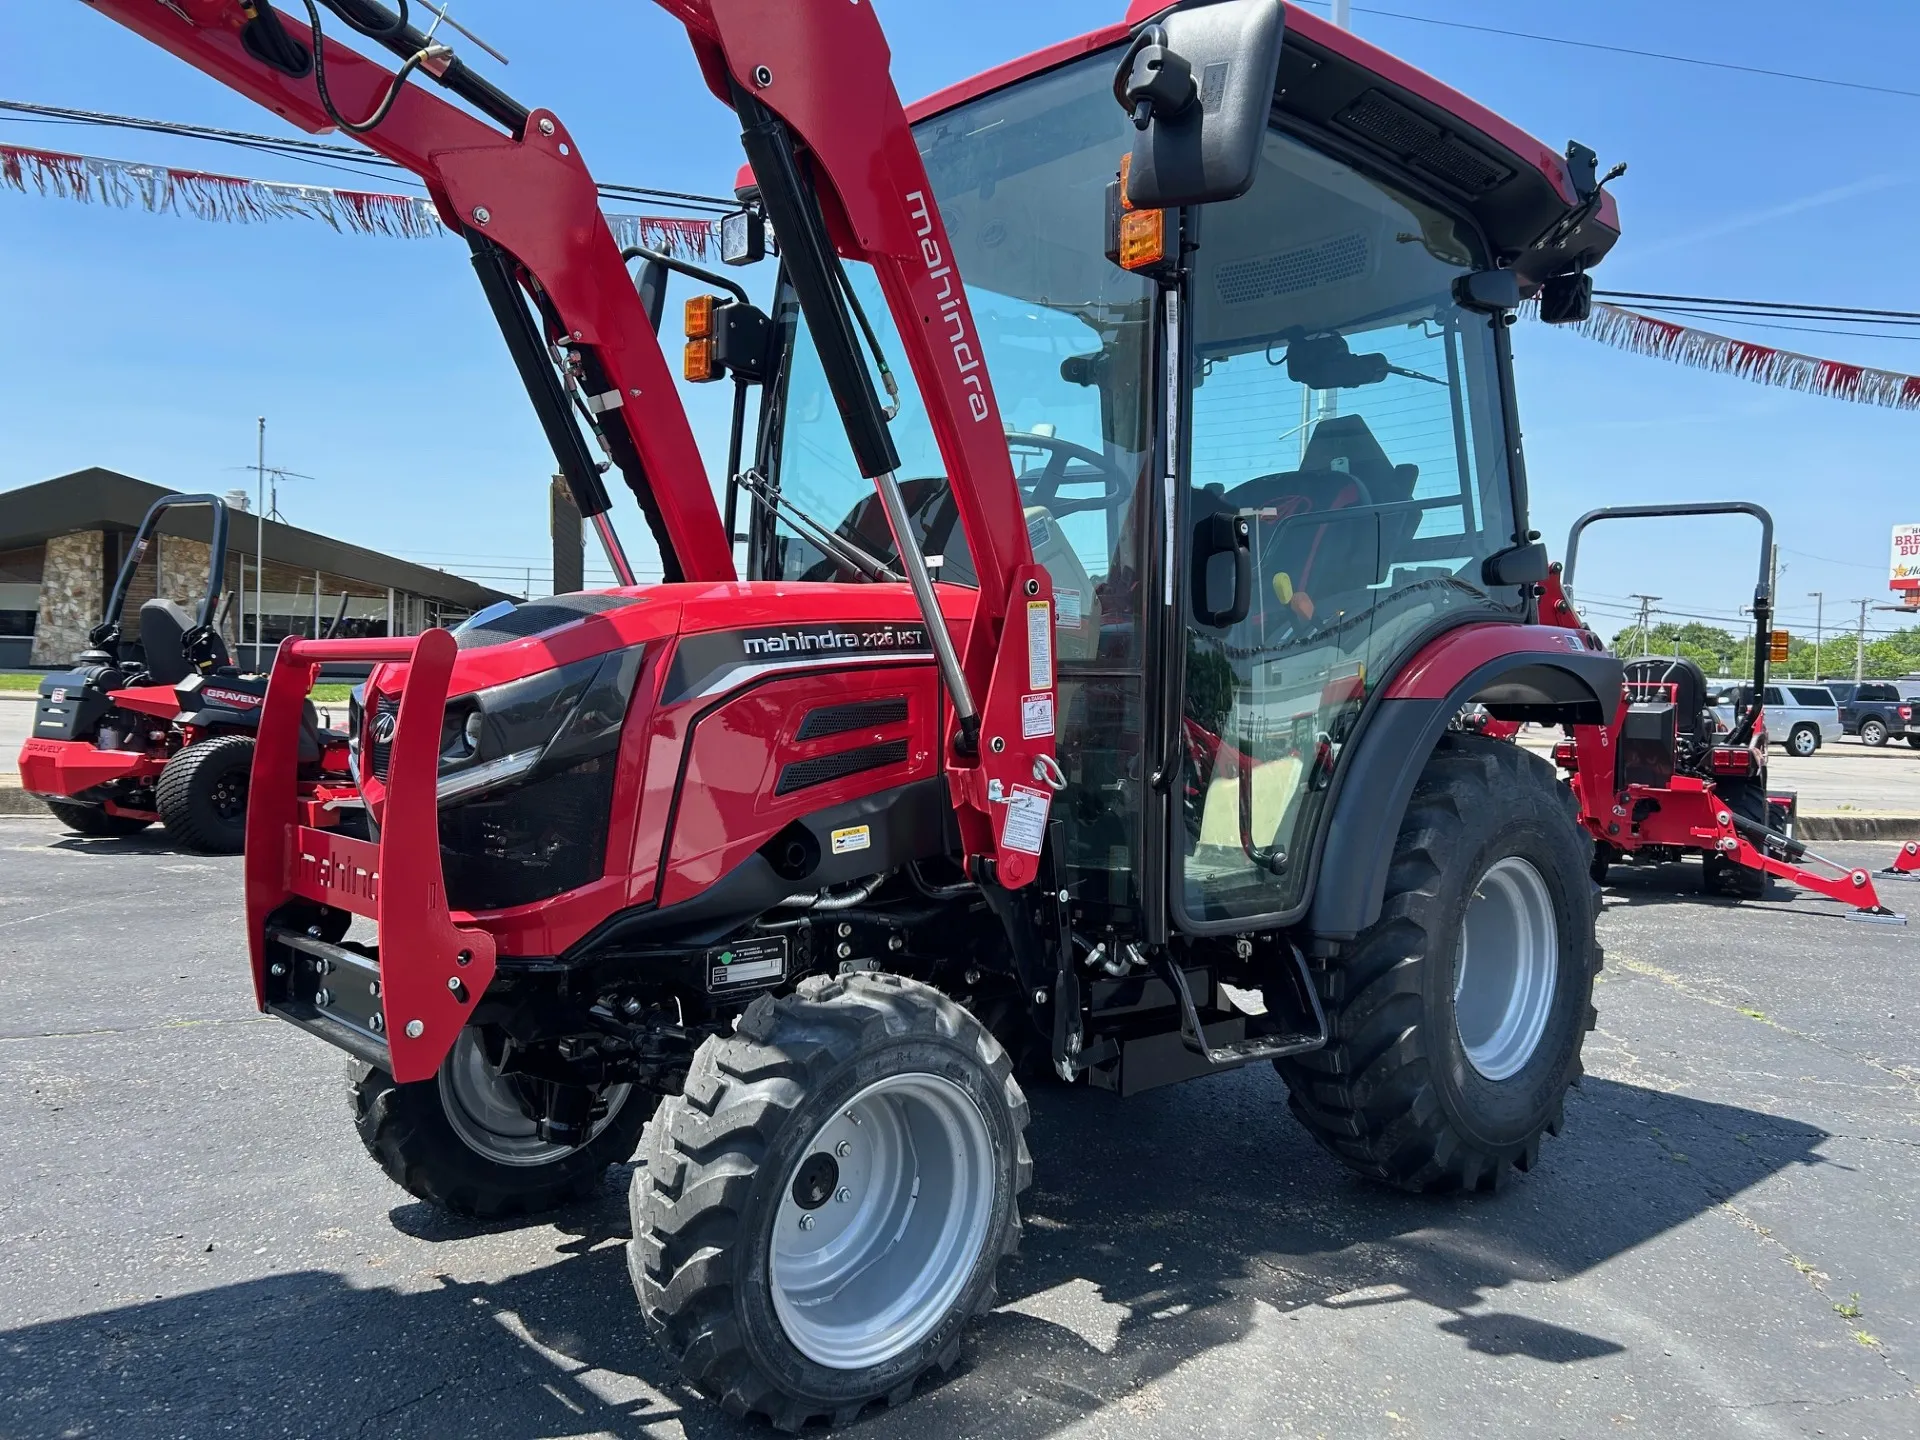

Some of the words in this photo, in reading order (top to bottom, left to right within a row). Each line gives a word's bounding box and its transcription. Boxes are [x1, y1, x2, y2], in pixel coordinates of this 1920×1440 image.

[906, 190, 988, 423] mahindra
[1900, 546, 1920, 555] BU
[743, 630, 860, 653] mahindra
[897, 631, 922, 645] HST
[206, 689, 261, 704] GRAVELY
[28, 744, 63, 753] GRAVELY
